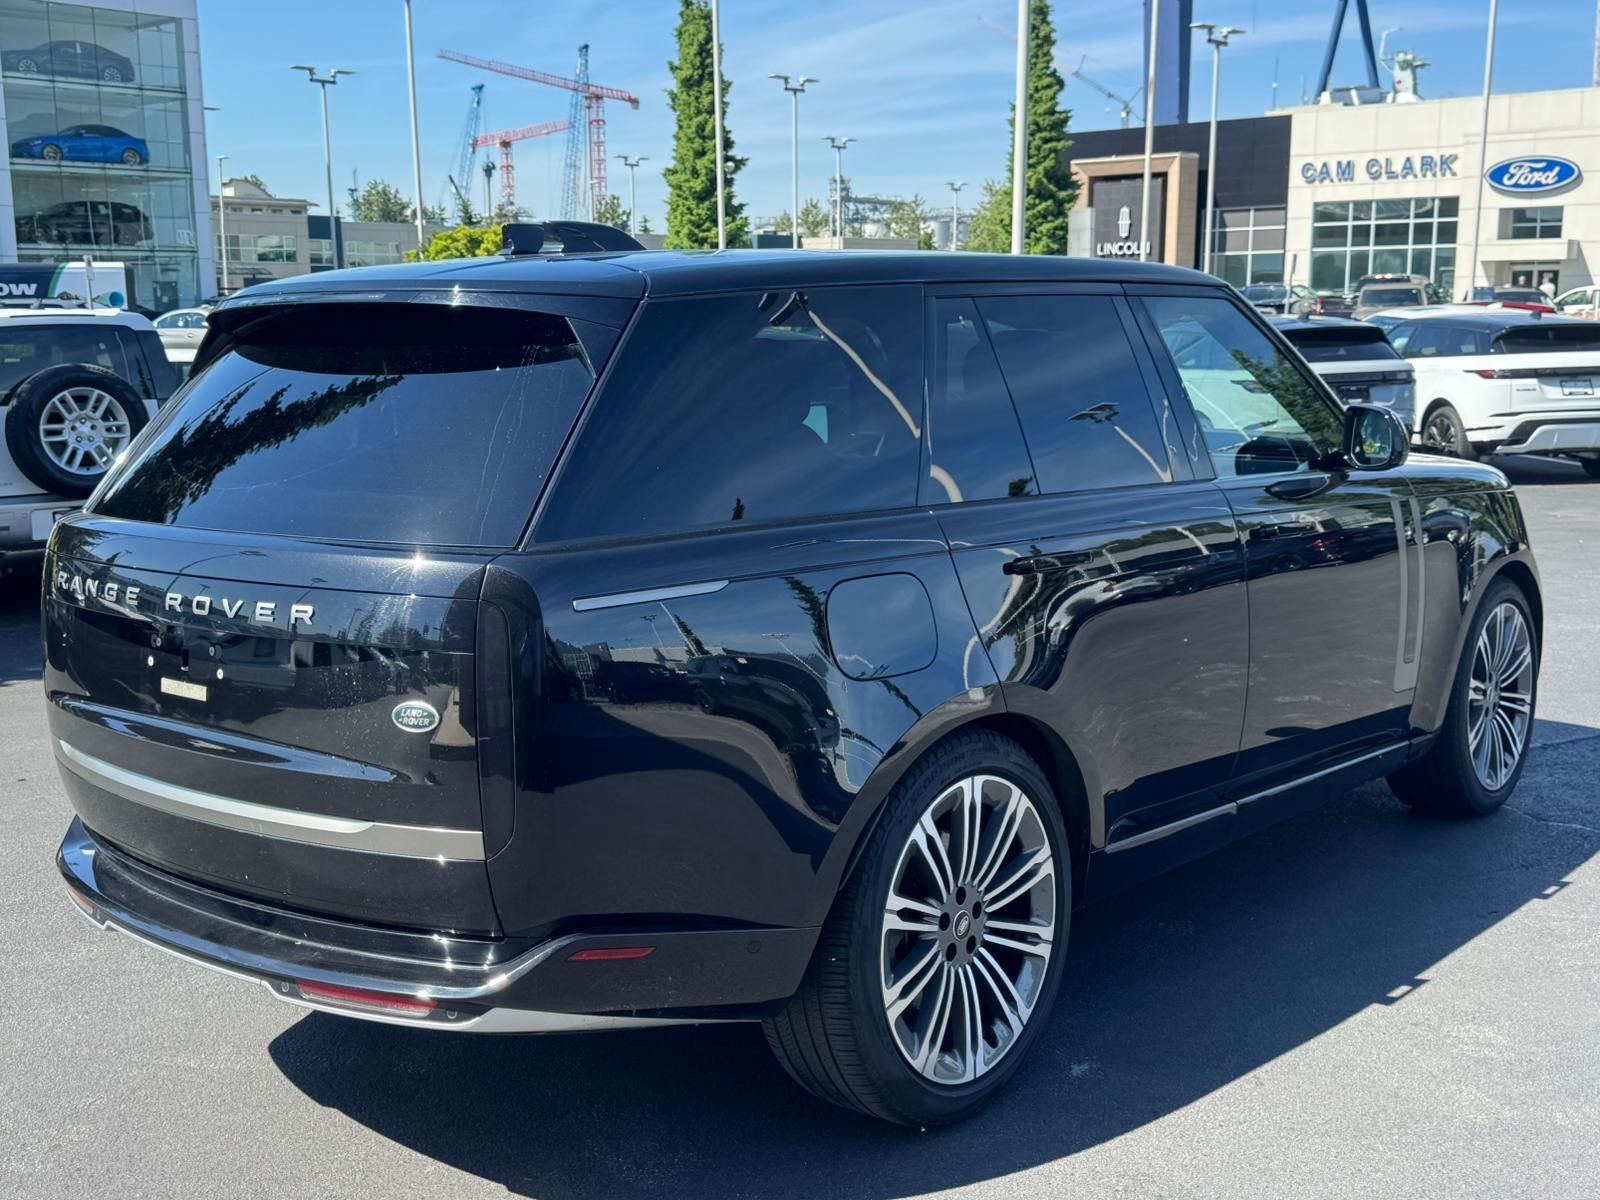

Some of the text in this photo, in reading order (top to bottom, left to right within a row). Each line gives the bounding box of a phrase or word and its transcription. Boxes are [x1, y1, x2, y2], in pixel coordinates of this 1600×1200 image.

[1301, 154, 1458, 183] CAM CLARK
[1502, 161, 1561, 186] Ford
[57, 570, 315, 626] RANGE ROVER
[400, 708, 423, 718] LAND
[402, 717, 430, 727] ROVER
